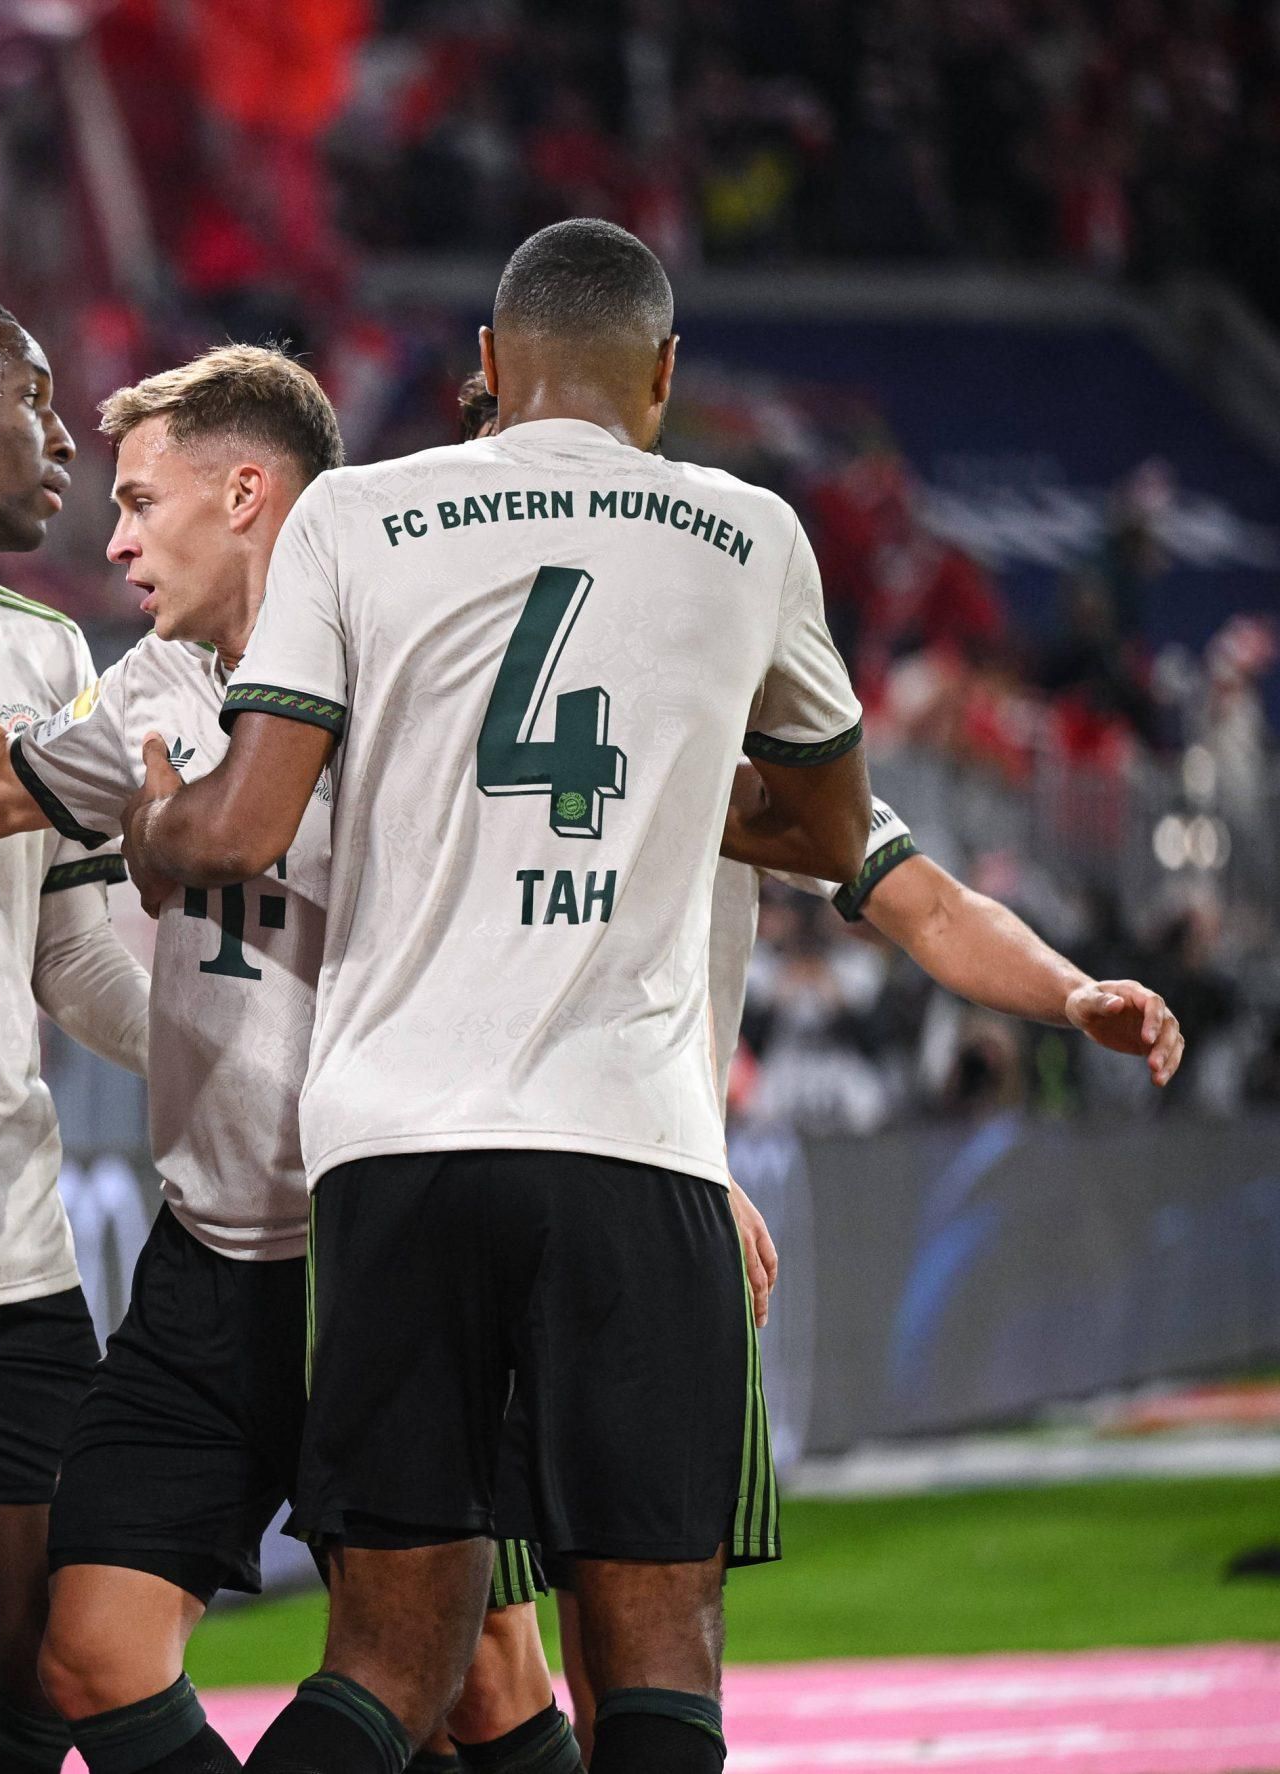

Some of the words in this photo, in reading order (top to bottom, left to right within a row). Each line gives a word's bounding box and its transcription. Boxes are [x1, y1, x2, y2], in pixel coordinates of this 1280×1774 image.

[382, 509, 428, 547] FC
[437, 490, 574, 530] BAYERN
[588, 490, 754, 566] MÜNCHEN
[477, 565, 627, 839] 4
[516, 869, 617, 925] TAH
